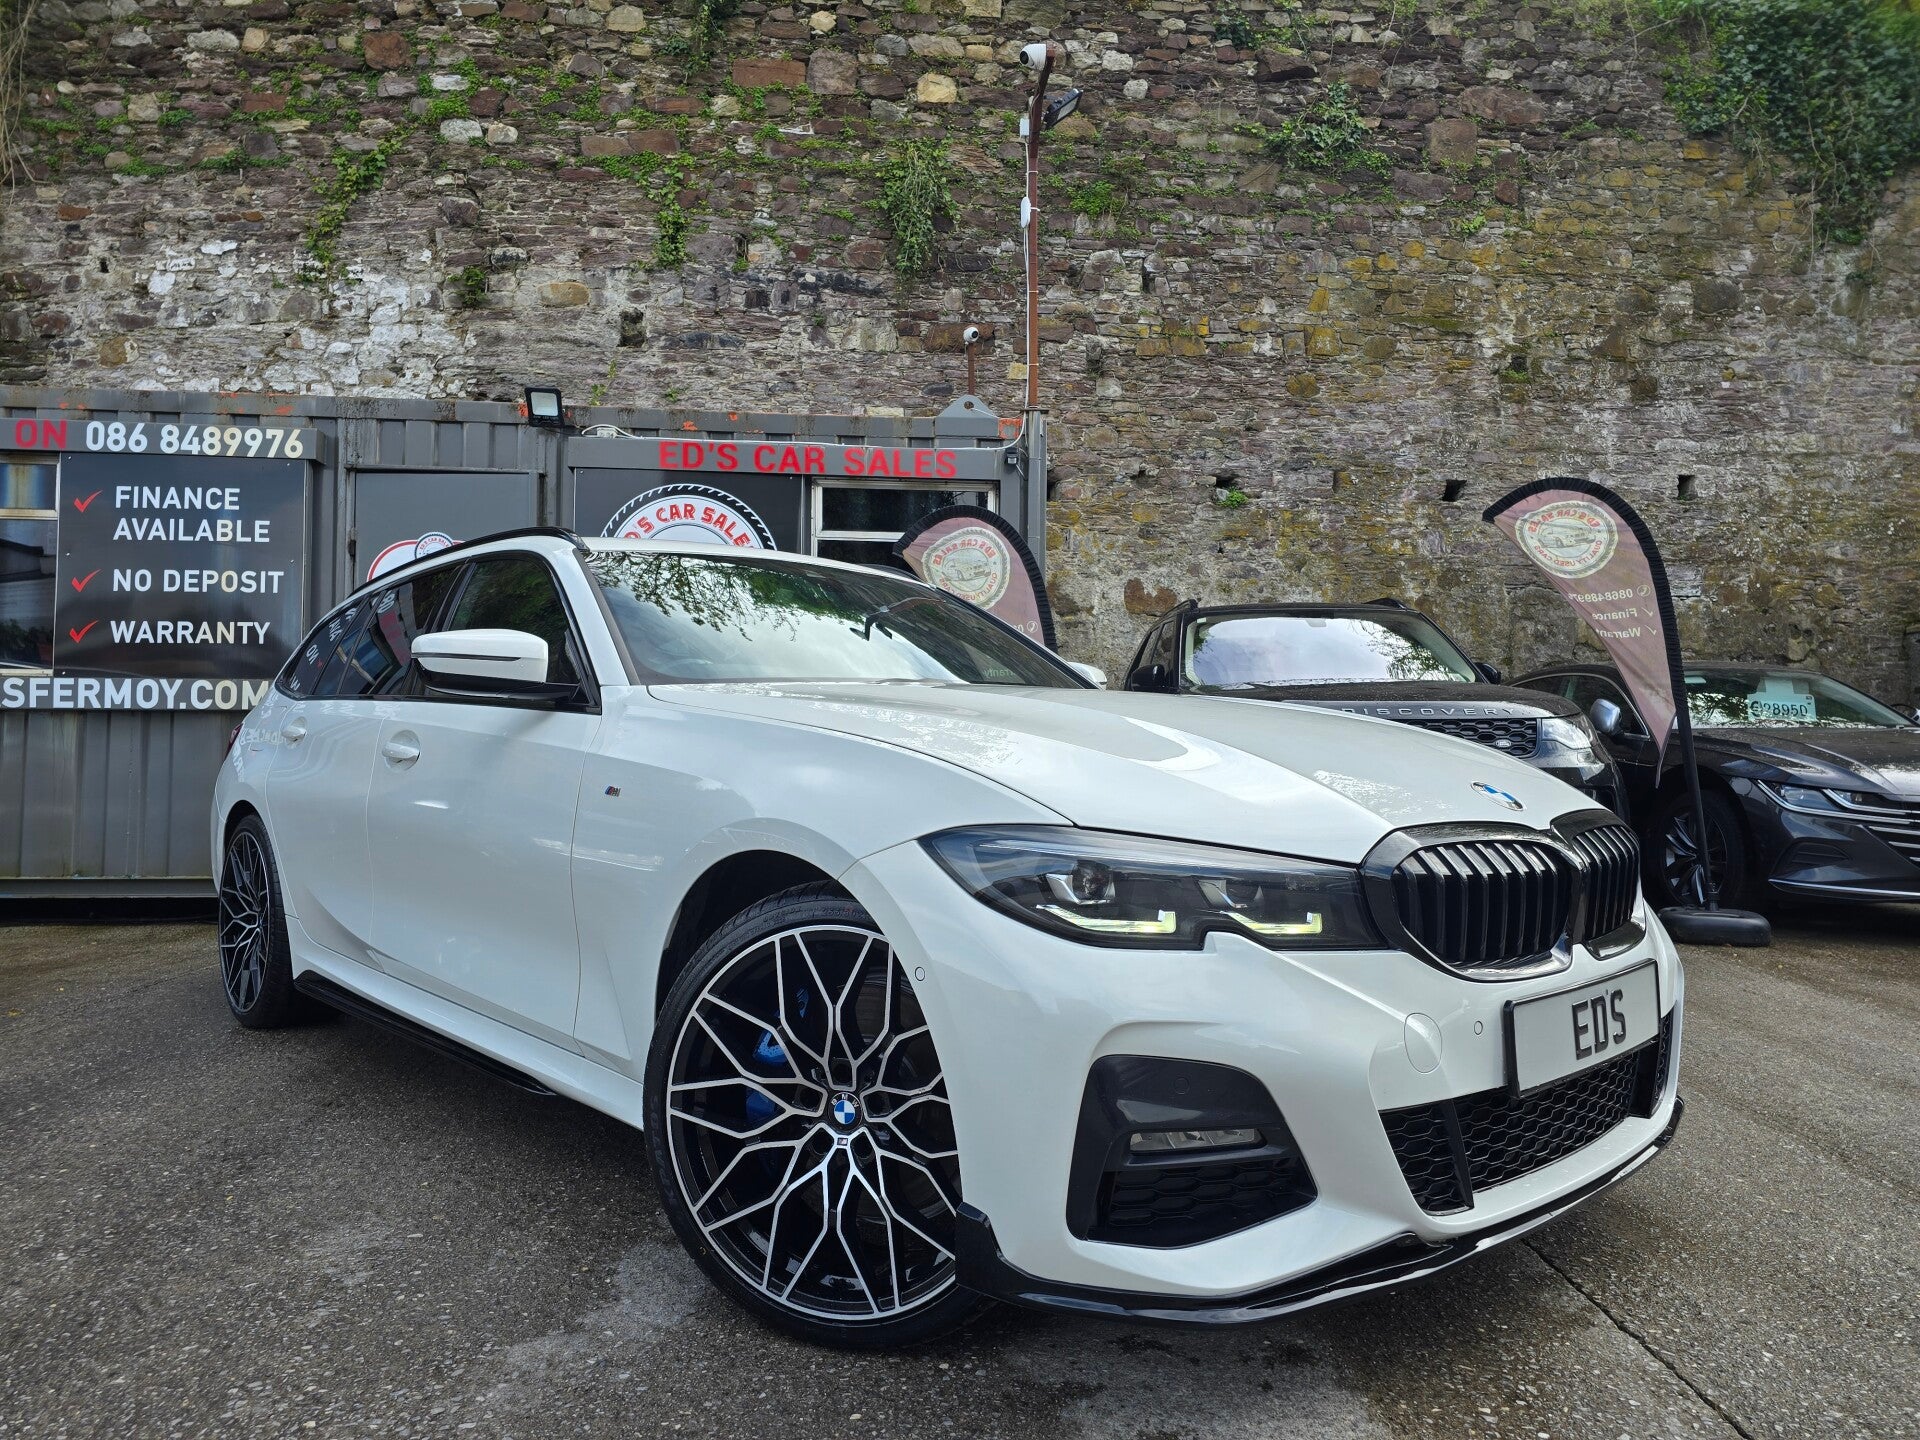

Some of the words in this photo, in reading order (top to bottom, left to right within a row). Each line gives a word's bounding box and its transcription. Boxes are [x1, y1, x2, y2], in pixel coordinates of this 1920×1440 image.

[15, 419, 67, 449] ON
[86, 421, 148, 453] 086
[160, 424, 304, 459] 8489976
[659, 440, 739, 471] ED'S
[753, 444, 826, 474] CAR
[843, 447, 957, 478] SALES
[115, 485, 241, 510] FINANCE
[113, 518, 271, 543] AVAILABLE
[655, 503, 696, 522] CAR
[701, 506, 753, 548] SALE
[113, 568, 151, 592] NO
[163, 569, 285, 594] DEPOSIT
[110, 620, 271, 644] WARRANTY
[1572, 989, 1627, 1061] ED'S
[831, 1093, 860, 1108] BMW
